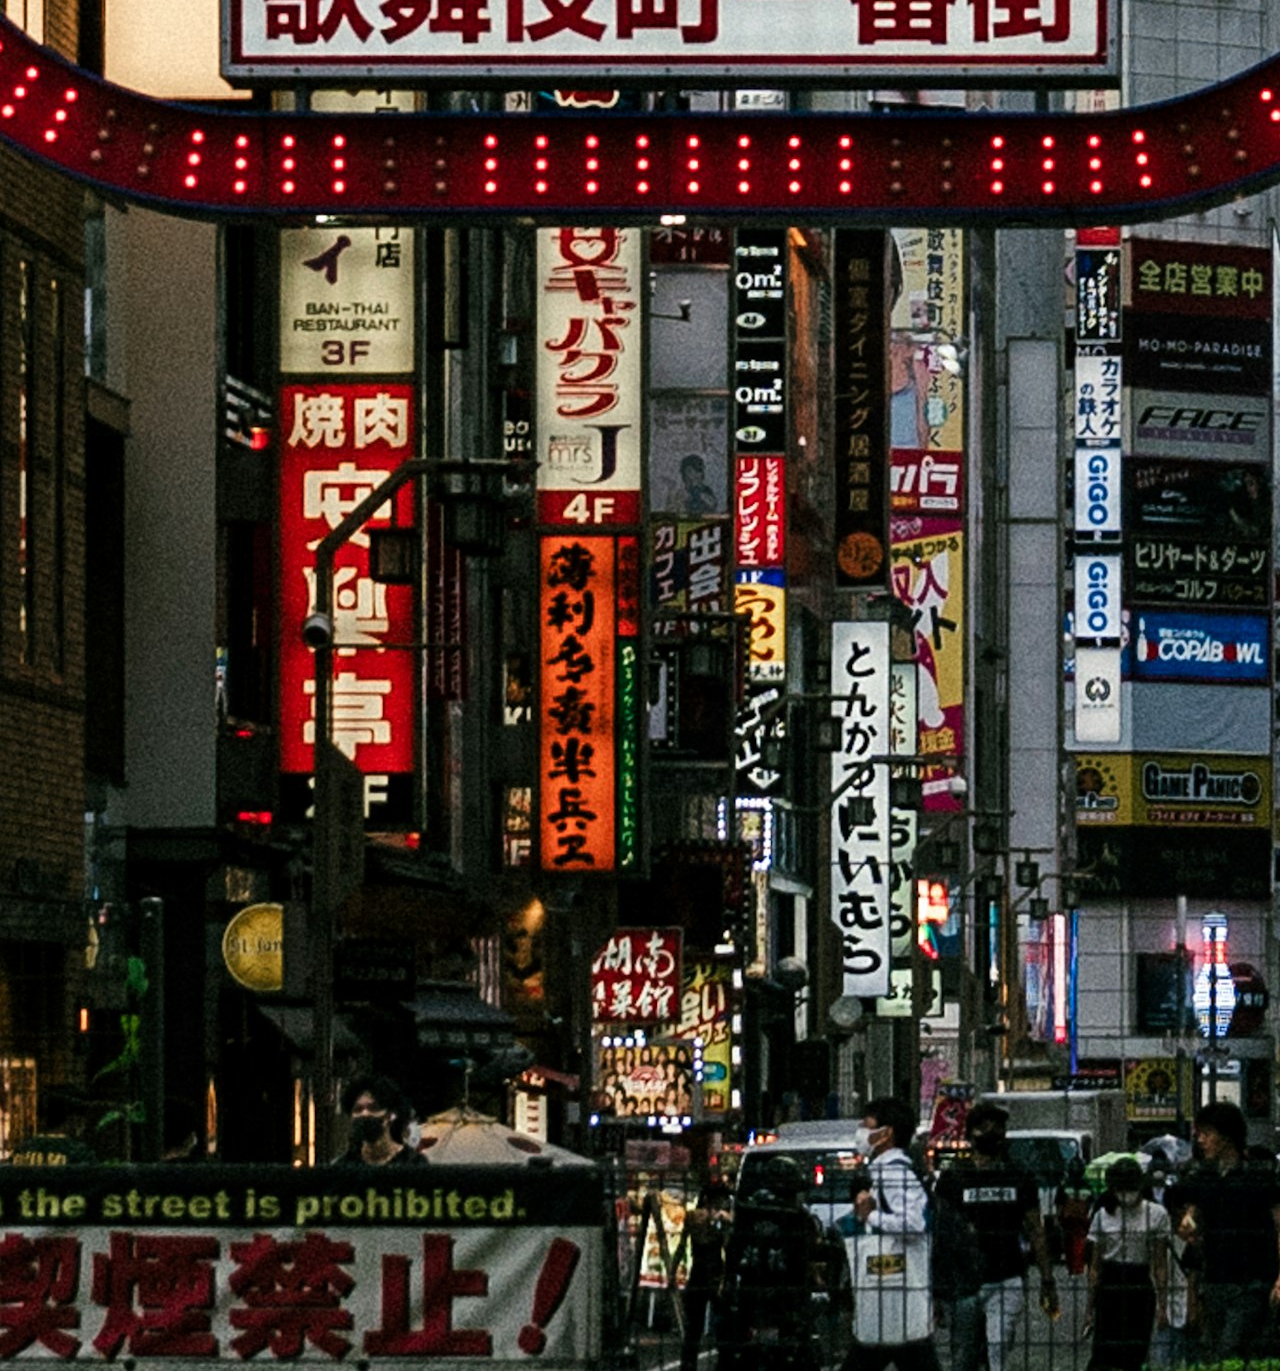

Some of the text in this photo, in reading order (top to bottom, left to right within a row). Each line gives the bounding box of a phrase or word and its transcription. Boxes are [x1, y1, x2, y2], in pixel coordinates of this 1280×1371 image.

[1139, 259, 1263, 299] 全店営業中
[293, 319, 401, 332] RESTAURANT
[306, 302, 389, 316] BAN-THAI
[320, 340, 371, 366] 3F
[1078, 383, 1098, 436] の鉄人
[1100, 359, 1120, 436] カラオケ
[287, 392, 409, 450] 焼肉
[1138, 405, 1266, 432] FACE
[562, 493, 615, 524] 4F
[1087, 454, 1109, 525] GiGO
[1135, 542, 1266, 574] ビリヤード&ダーツ
[1087, 561, 1109, 632] GiGO
[1175, 579, 1218, 600] ゴルフ
[837, 641, 883, 974] とんかつにいむら
[19, 1183, 85, 1218] the
[102, 1184, 230, 1218] street
[245, 1188, 280, 1220] is
[296, 1188, 526, 1225] prohibited.
